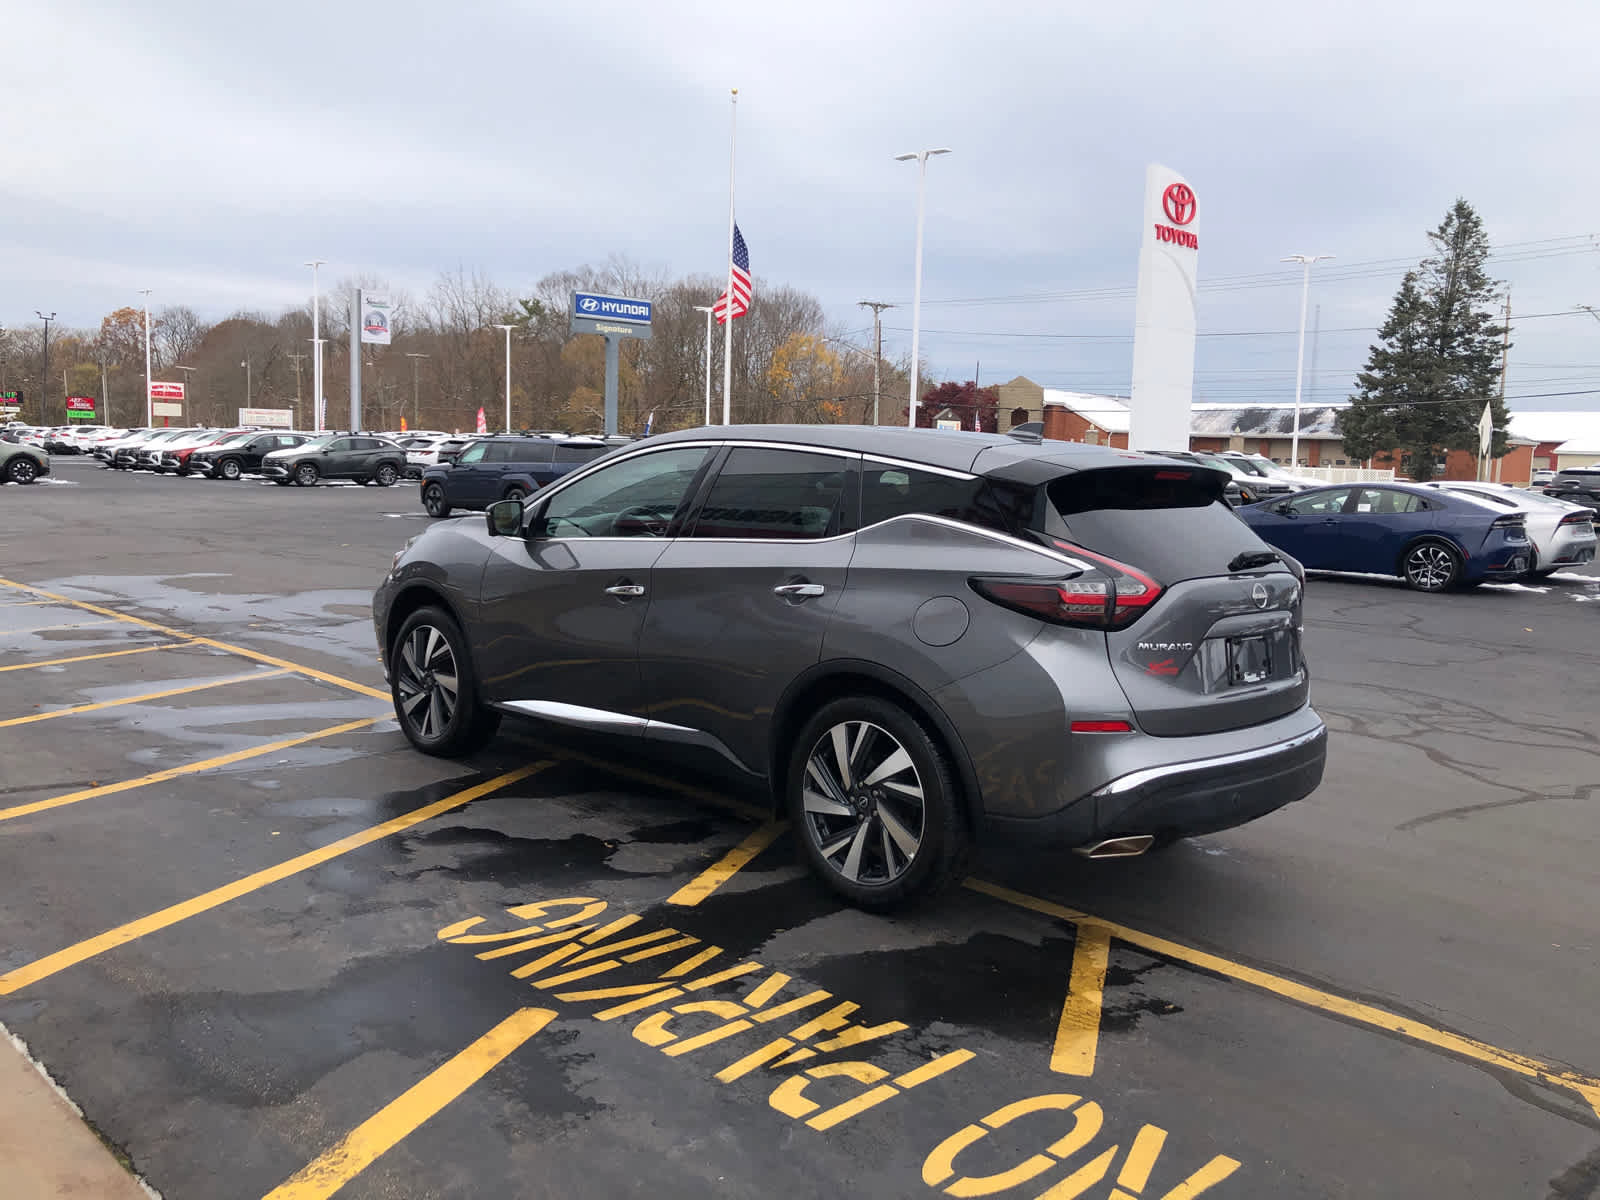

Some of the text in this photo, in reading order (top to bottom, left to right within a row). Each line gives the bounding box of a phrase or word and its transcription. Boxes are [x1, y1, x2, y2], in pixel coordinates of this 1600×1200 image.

[1155, 225, 1198, 250] TOYOTA
[602, 302, 649, 316] HYUNDAI
[1136, 641, 1193, 652] MURANO
[436, 895, 977, 1133] PARKING
